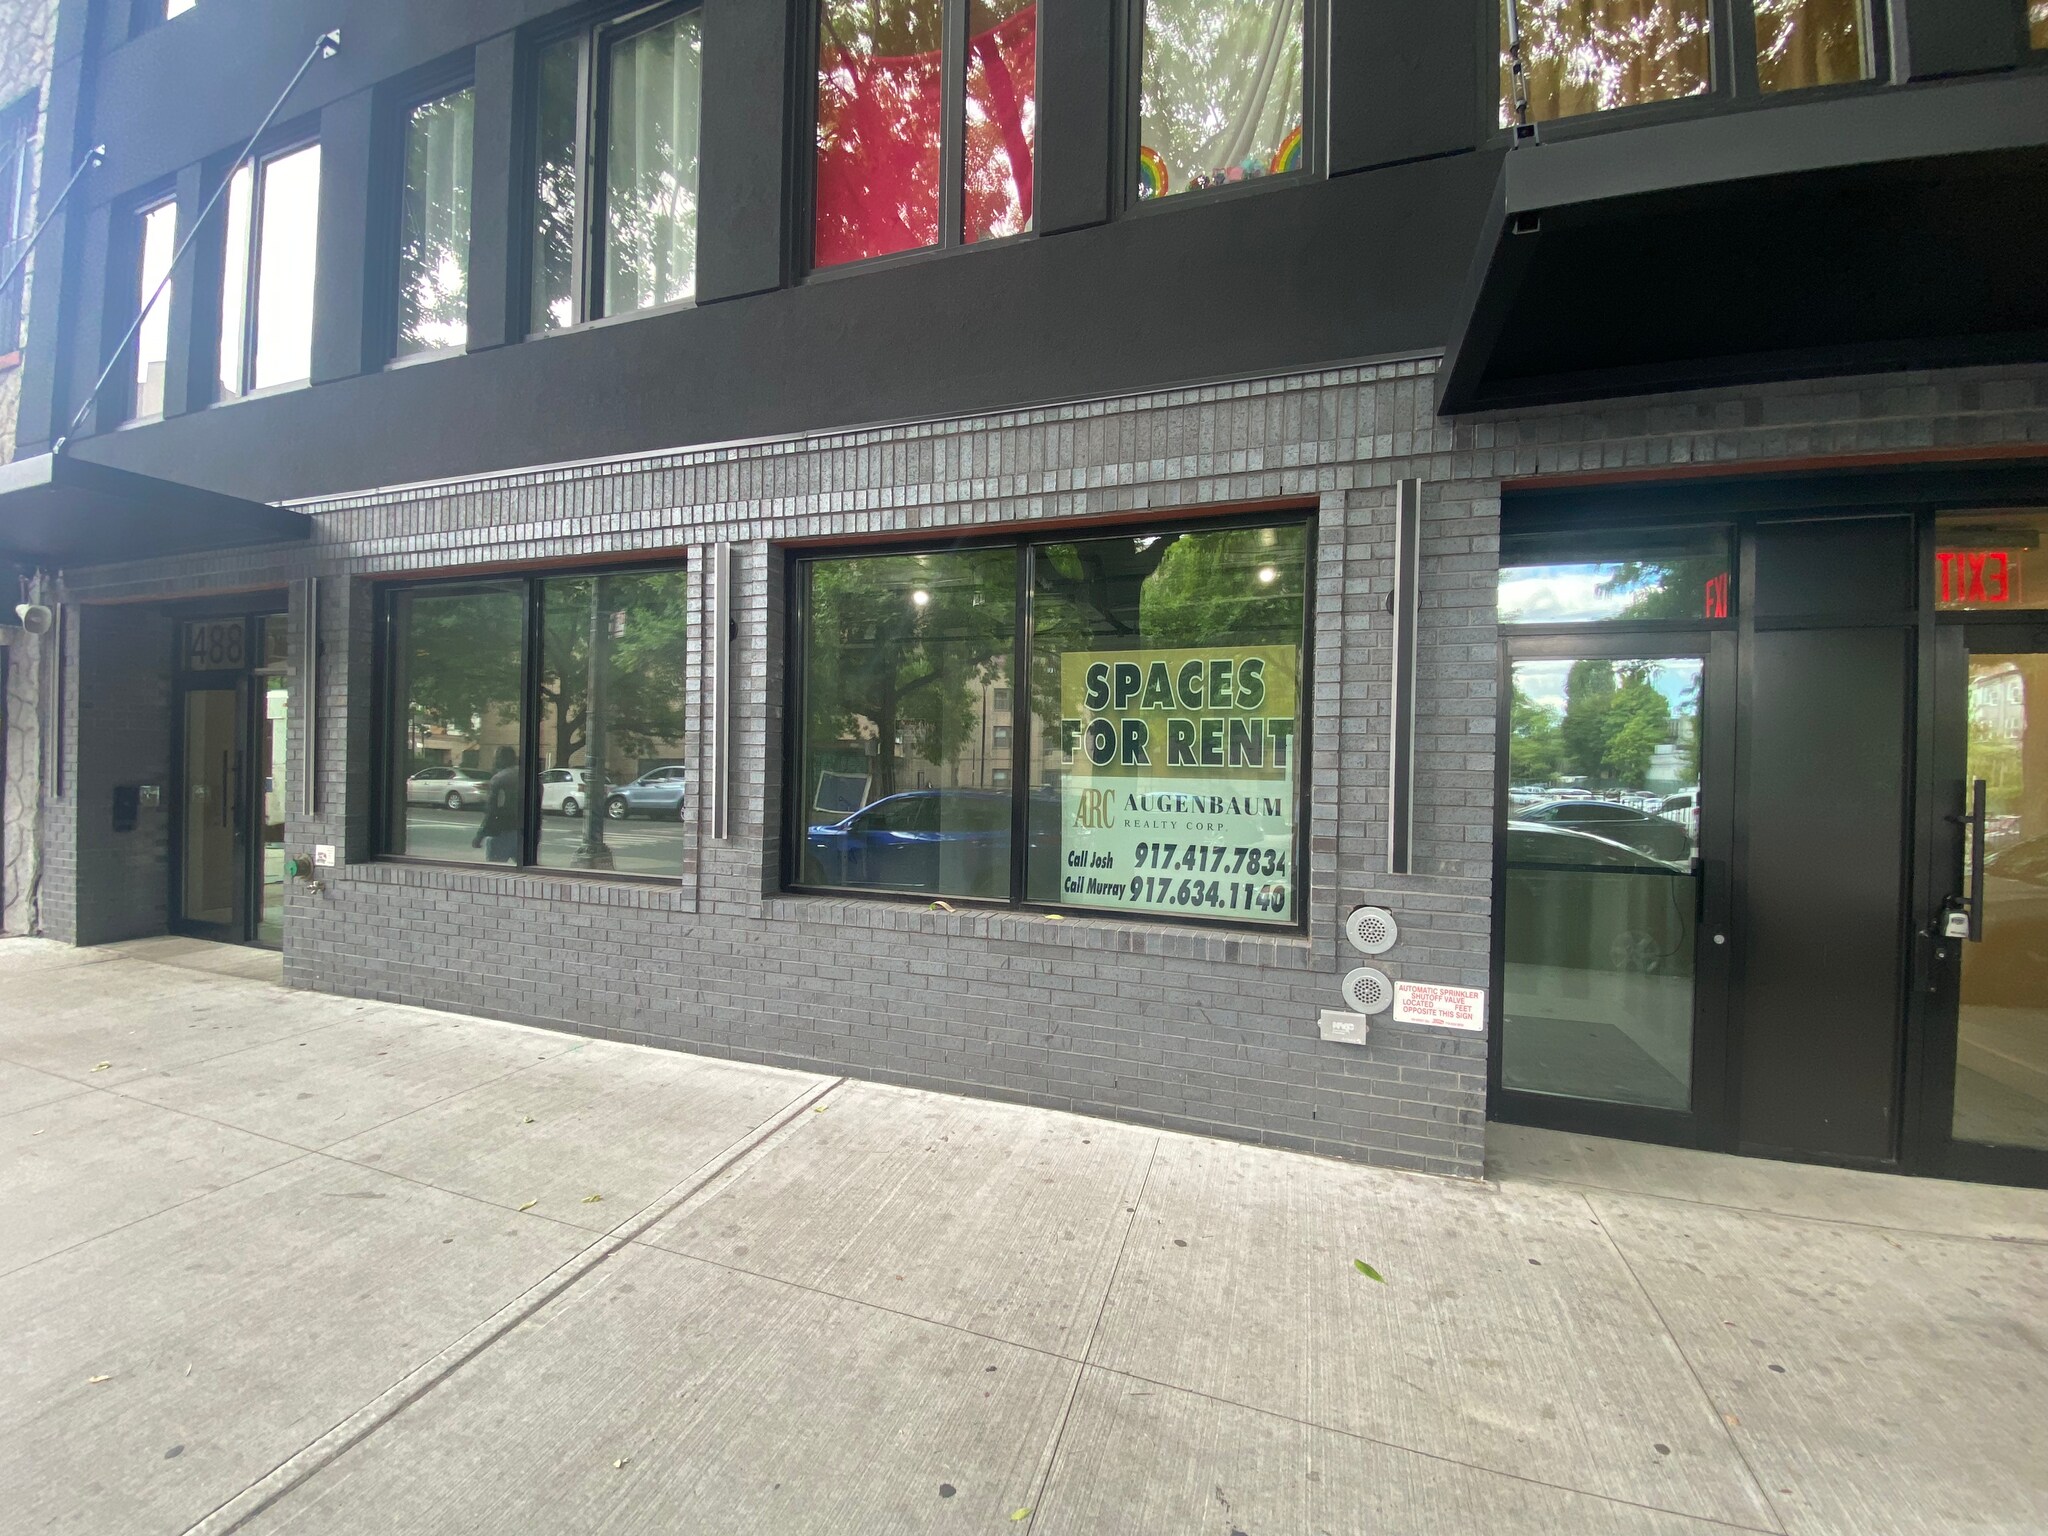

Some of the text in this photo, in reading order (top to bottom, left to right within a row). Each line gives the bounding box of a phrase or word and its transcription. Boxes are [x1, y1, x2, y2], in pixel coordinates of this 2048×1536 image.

[190, 623, 244, 664] 488
[1084, 658, 1266, 711] SPACES
[1061, 717, 1295, 768] FOR RENT
[1072, 788, 1116, 829] ARC
[1123, 793, 1282, 817] AUGENBAUM
[1124, 819, 1228, 832] REALTY CORP.
[1068, 841, 1286, 878] Call Josh 917.417.7834
[1064, 875, 1285, 913] Call Murray 917.634.1140
[1399, 985, 1479, 999] AUTOMATIC SPRINKLER
[1402, 999, 1472, 1013] LOCATED FEET
[1411, 993, 1465, 1005] SHUTOFF VALVE
[1402, 1006, 1473, 1020] OPPOSITE THIS SIGN
